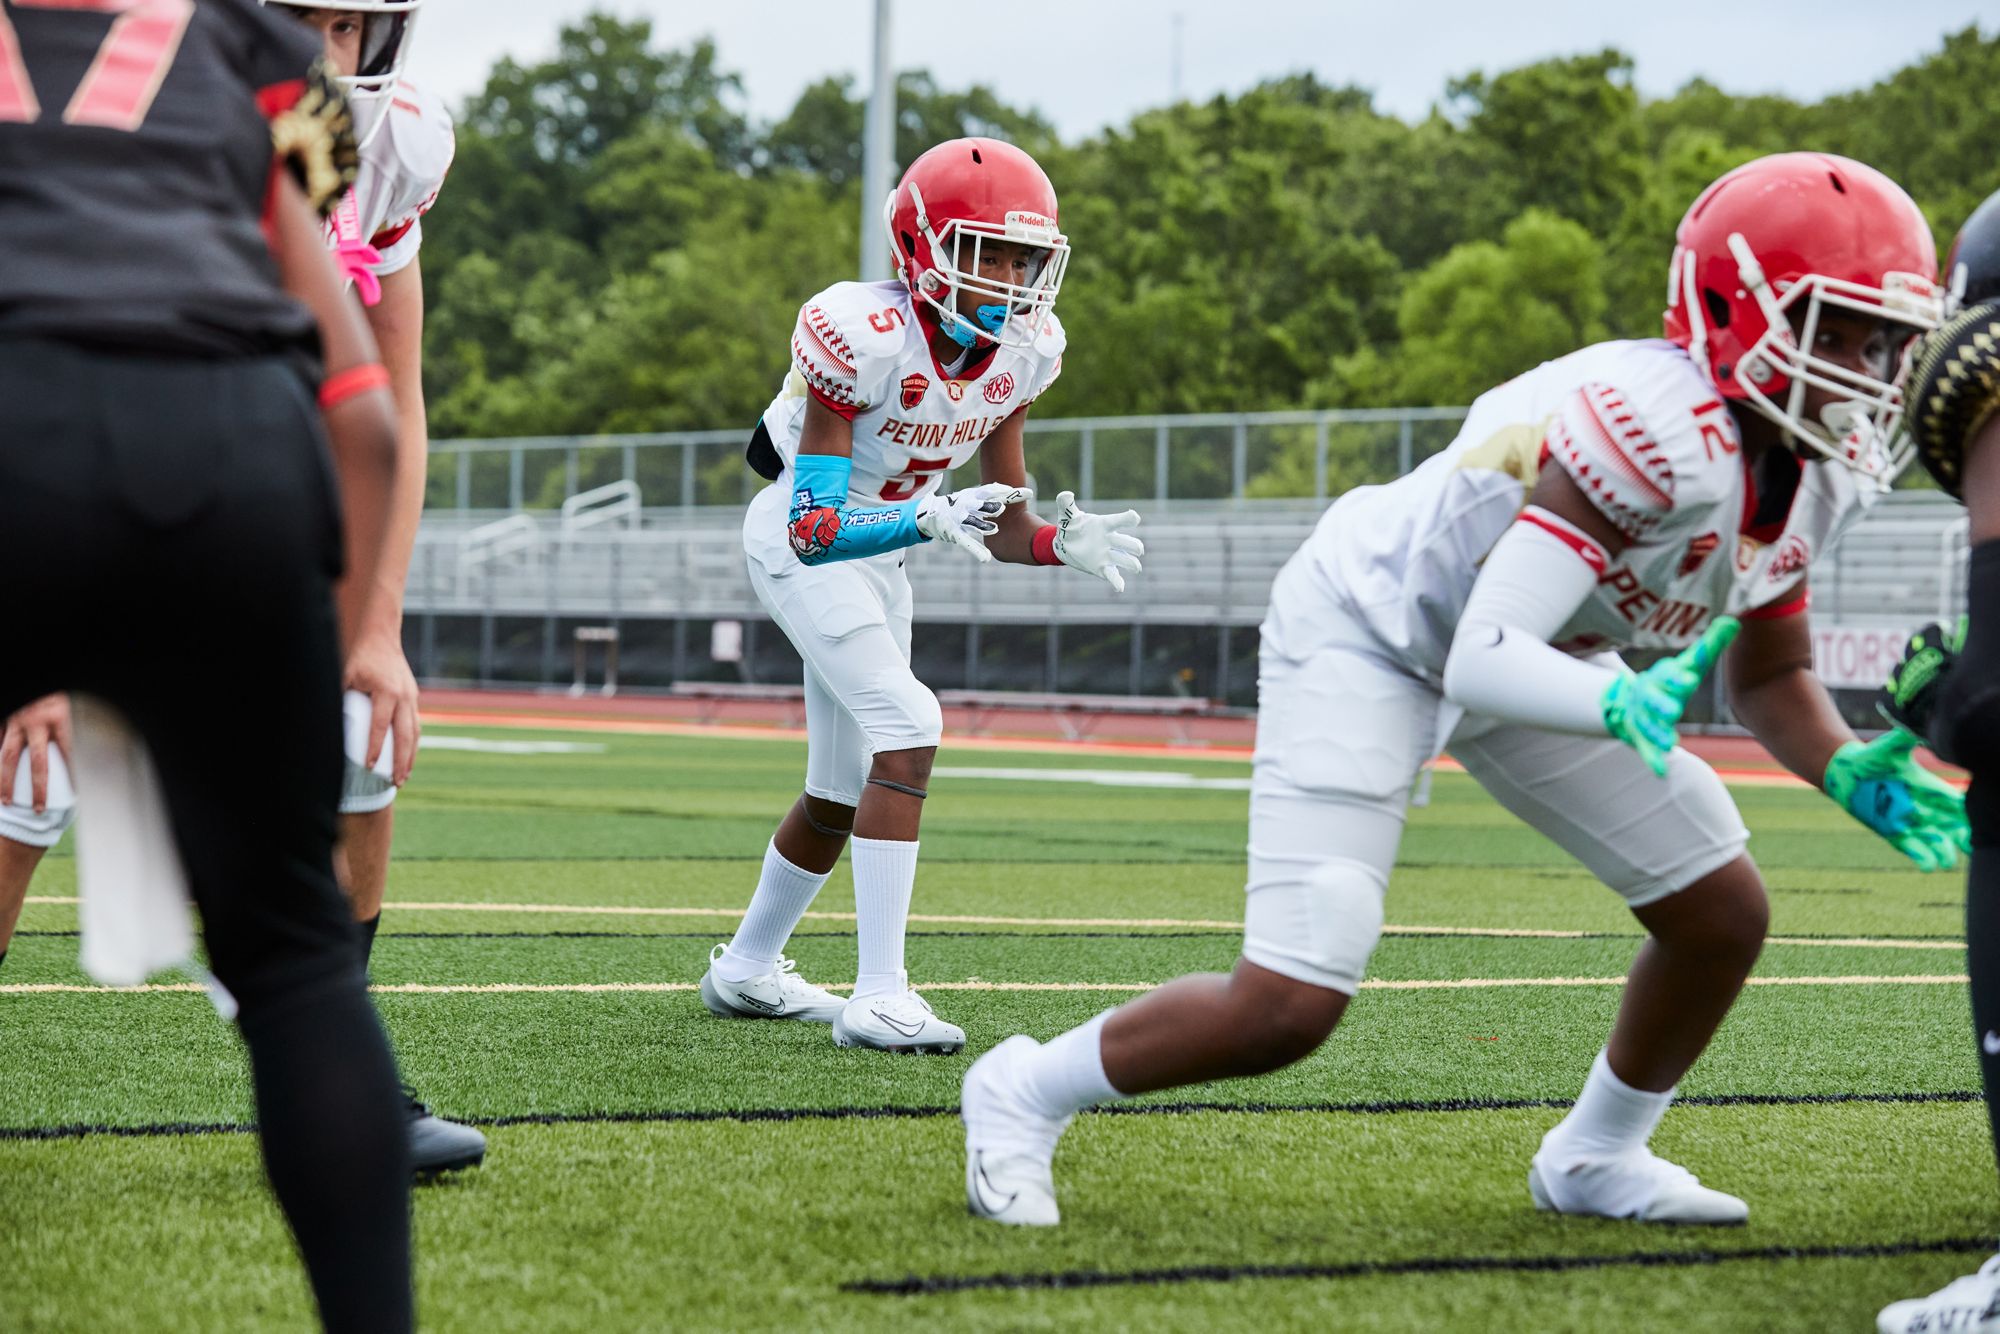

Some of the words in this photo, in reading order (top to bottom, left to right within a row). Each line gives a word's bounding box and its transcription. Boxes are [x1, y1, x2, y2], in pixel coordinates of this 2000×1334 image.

[0, 0, 196, 132] 7
[1018, 214, 1045, 227] Riddell
[868, 306, 906, 334] 5
[914, 378, 928, 388] EAST
[877, 417, 948, 448] PENN
[1691, 398, 1740, 463] 12
[879, 456, 953, 503] 5
[844, 510, 901, 526] SHOCK
[1597, 563, 1709, 638] PENN
